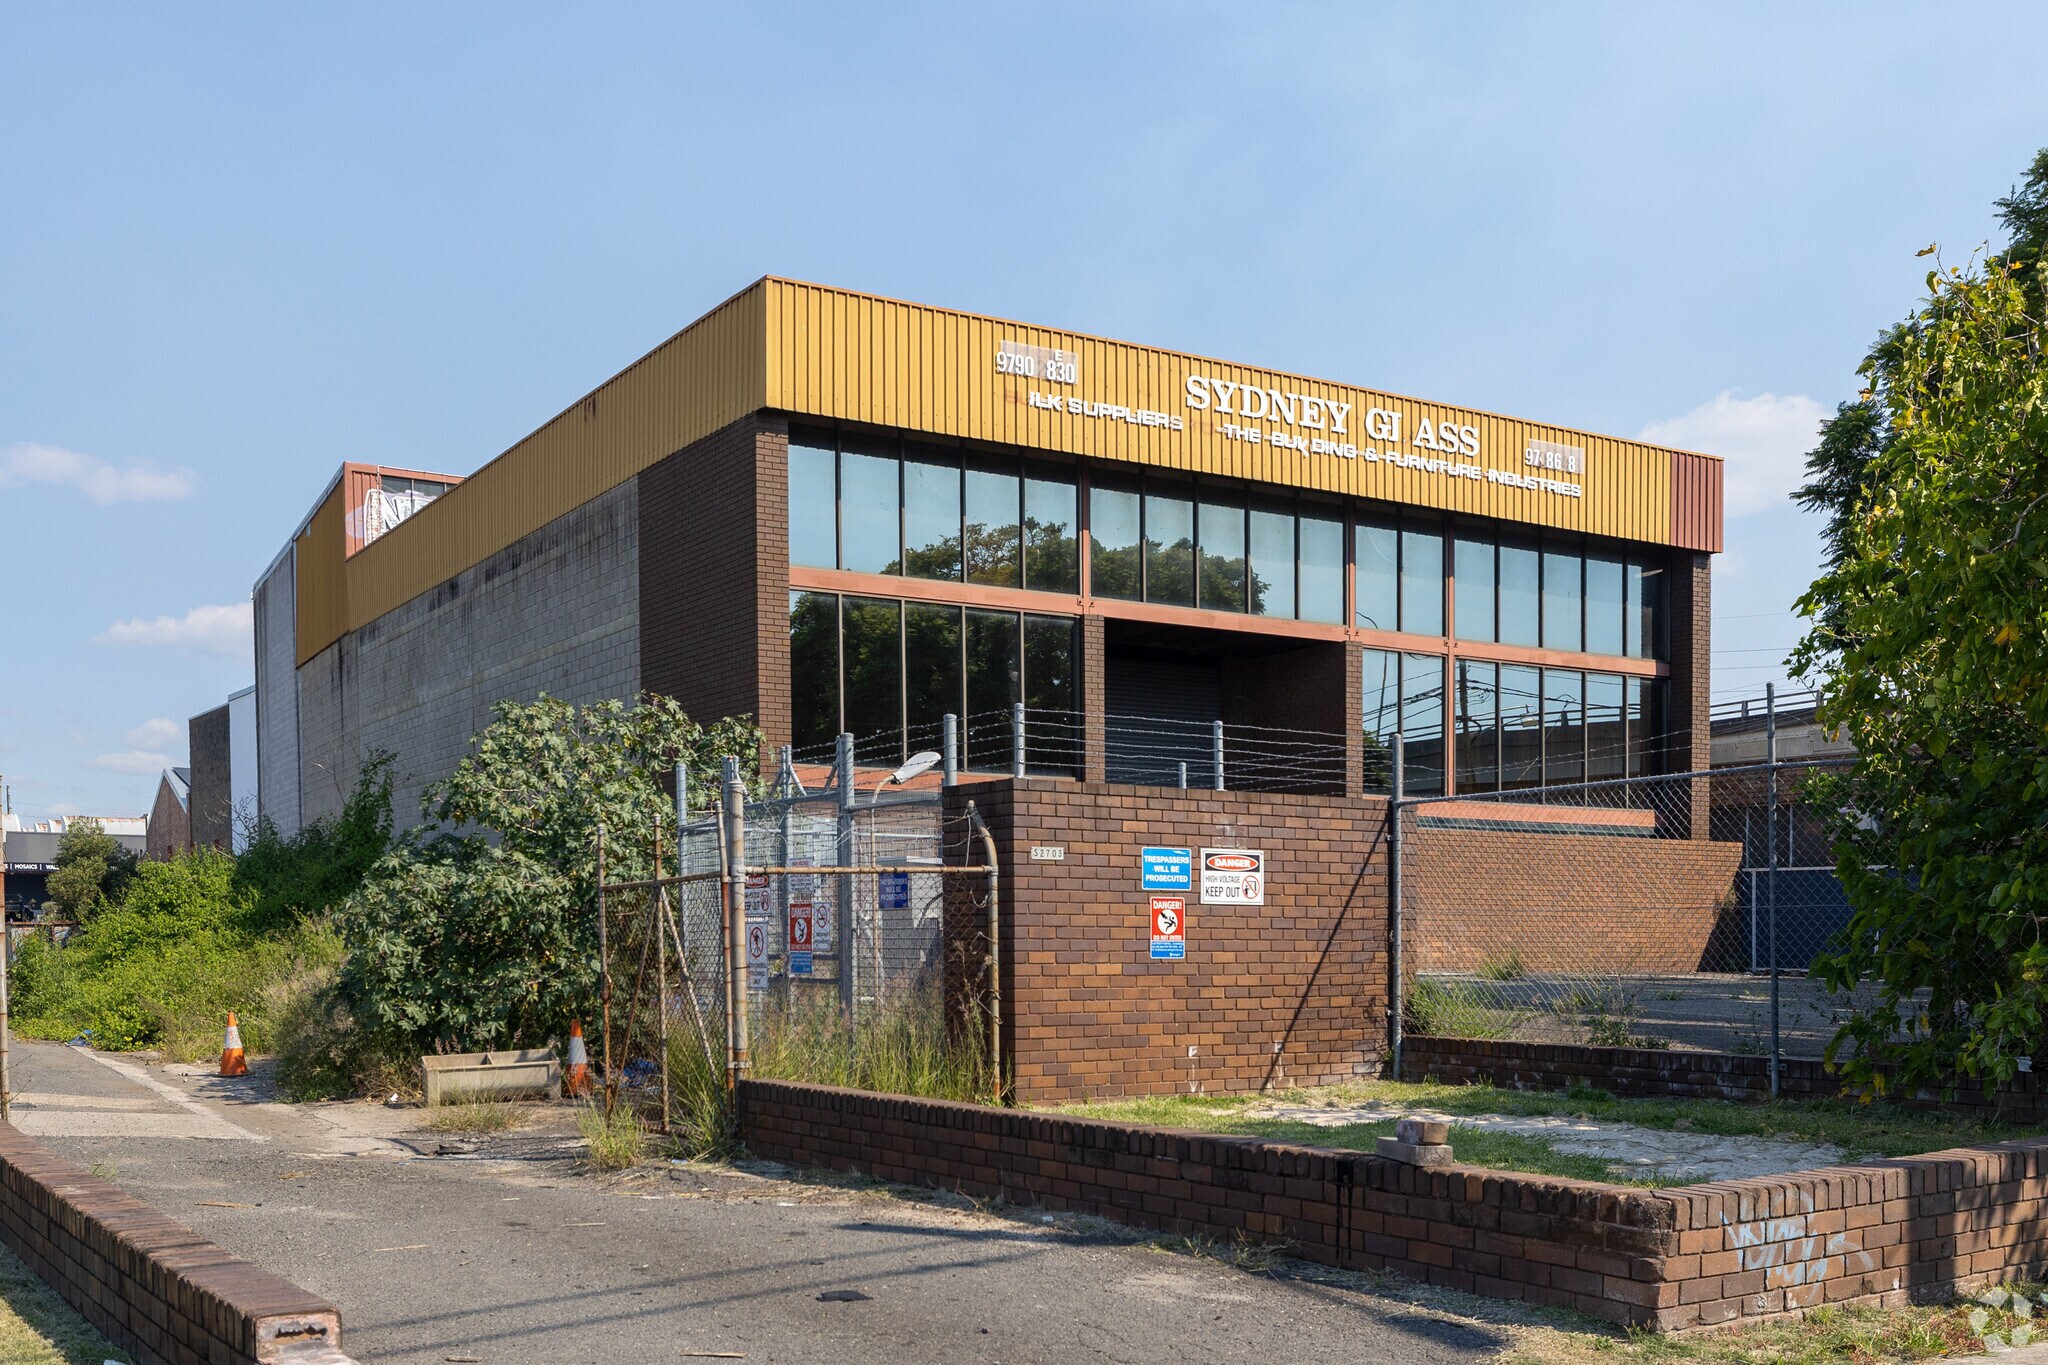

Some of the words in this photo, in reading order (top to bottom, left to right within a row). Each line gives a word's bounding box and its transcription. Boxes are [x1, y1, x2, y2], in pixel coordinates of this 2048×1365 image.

[996, 351, 1035, 376] 9790
[1046, 359, 1076, 384] 830
[1185, 374, 1352, 435] SYDNEY
[1067, 397, 1184, 430] SUPPLIERS
[1223, 423, 1262, 443] THE
[1364, 447, 1380, 462] &
[1385, 450, 1482, 480] FURNITURE
[1488, 467, 1582, 498] INDUSTRIES
[1143, 855, 1190, 865] TRESPASSERS
[1214, 858, 1251, 868] DANGER
[1153, 865, 1170, 873] WILL
[1170, 865, 1180, 873] BE
[1145, 874, 1189, 883] PROSECUTED
[1205, 875, 1218, 883] HIGH
[1219, 875, 1241, 884] VOLTAGE
[1205, 886, 1224, 898] KEEP
[1226, 886, 1241, 898] OUT
[1153, 900, 1183, 910] DANGER!
